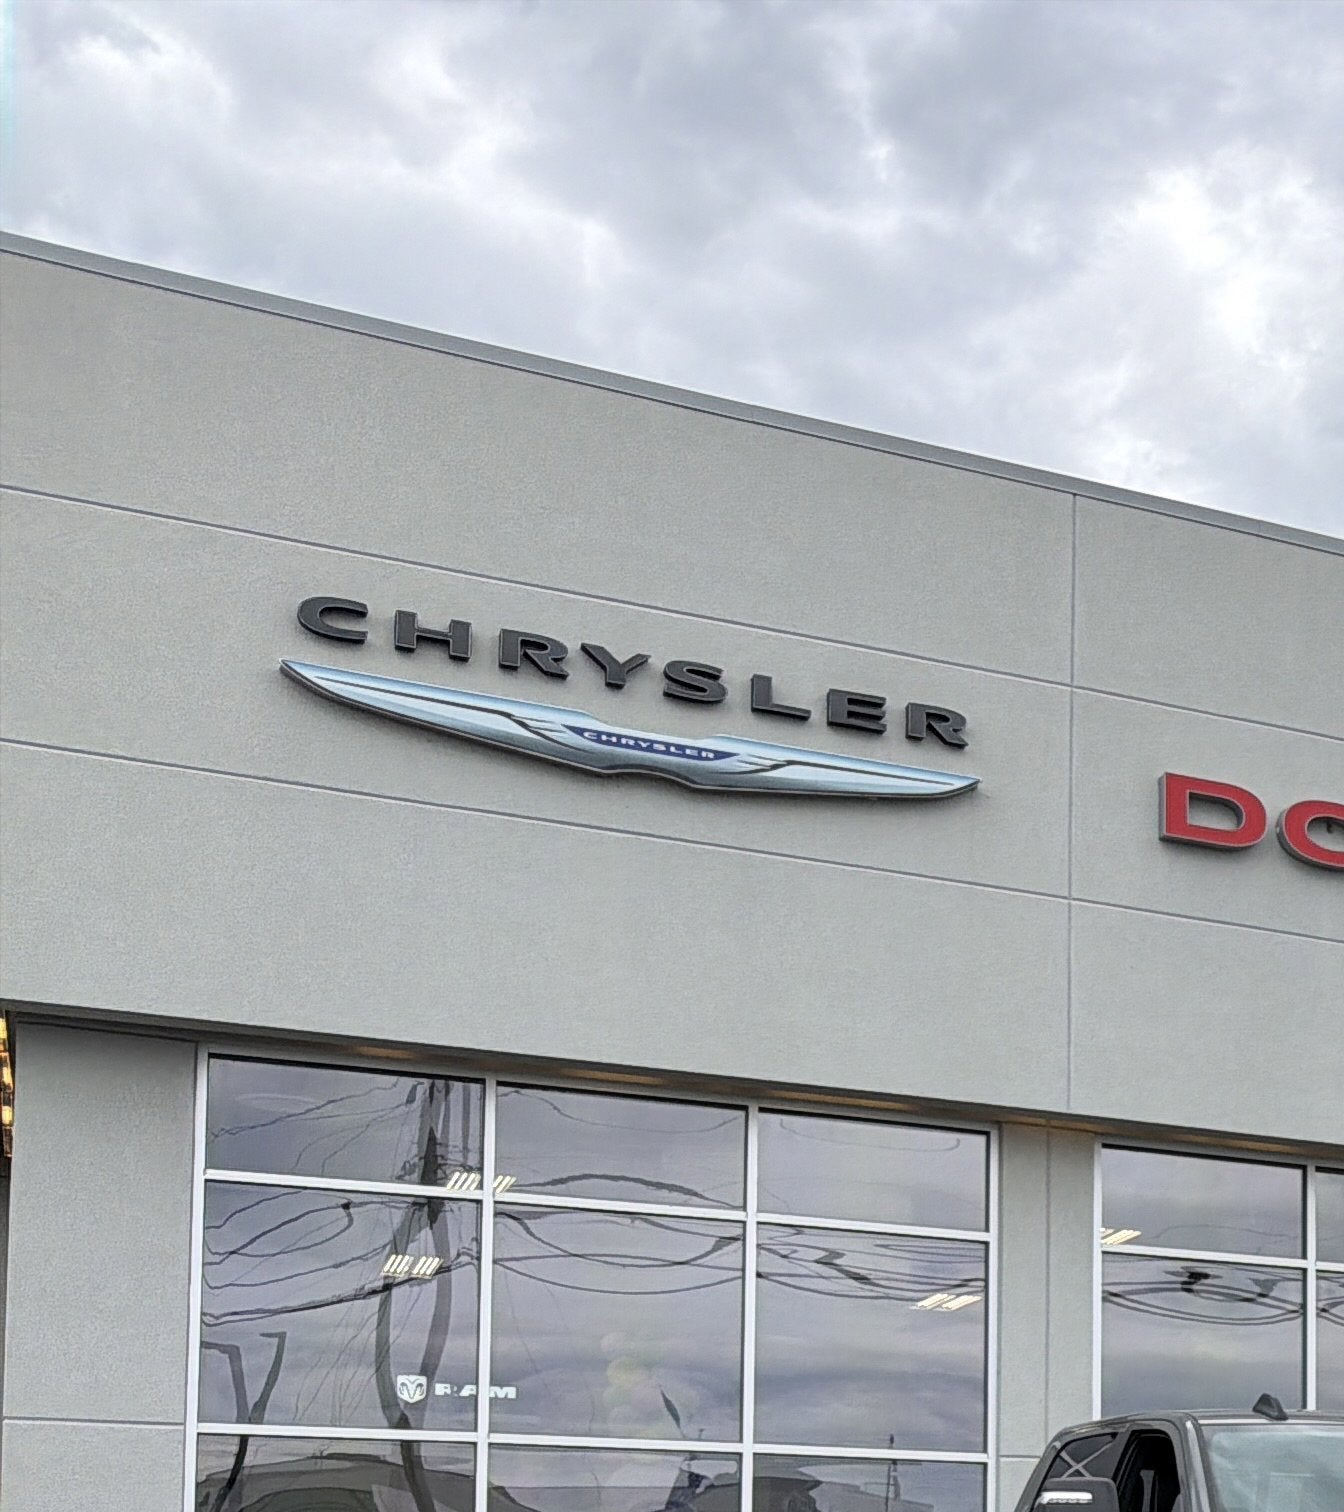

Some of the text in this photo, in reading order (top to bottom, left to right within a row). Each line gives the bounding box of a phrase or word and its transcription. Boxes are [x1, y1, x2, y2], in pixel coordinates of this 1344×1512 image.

[296, 595, 969, 749] CHRYSLER
[583, 731, 715, 759] CHRYSLER
[434, 1383, 517, 1399] RAM
